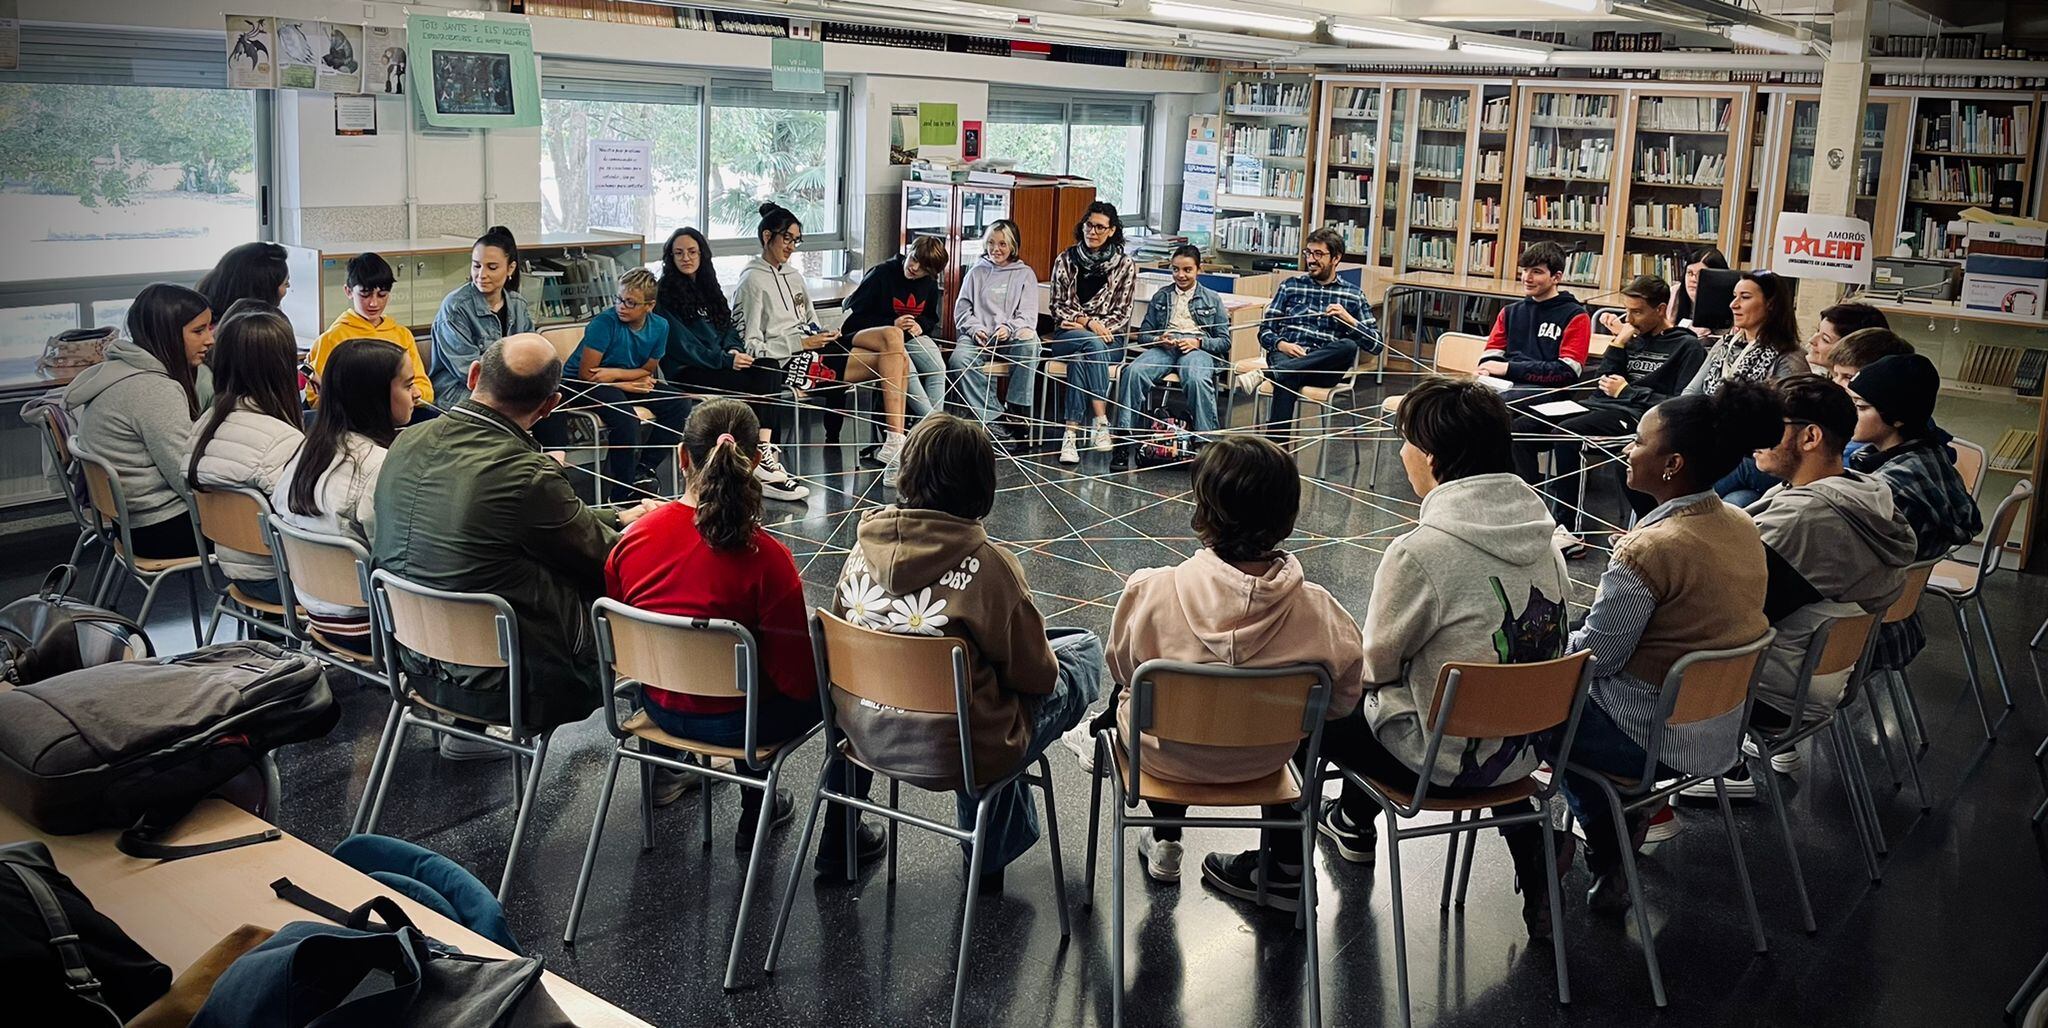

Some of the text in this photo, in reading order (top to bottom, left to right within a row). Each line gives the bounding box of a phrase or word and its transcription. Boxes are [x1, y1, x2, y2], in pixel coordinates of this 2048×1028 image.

[443, 22, 467, 32] SANTS
[484, 25, 498, 34] ELS
[502, 27, 531, 37] NOSTRES
[1783, 227, 1865, 261] TALENT
[1827, 231, 1866, 241] AMORÓS
[1537, 322, 1562, 341] GAP
[785, 355, 801, 386] CHICA
[795, 352, 812, 385] BULLS
[960, 556, 980, 573] TO
[939, 570, 973, 591] DAY
